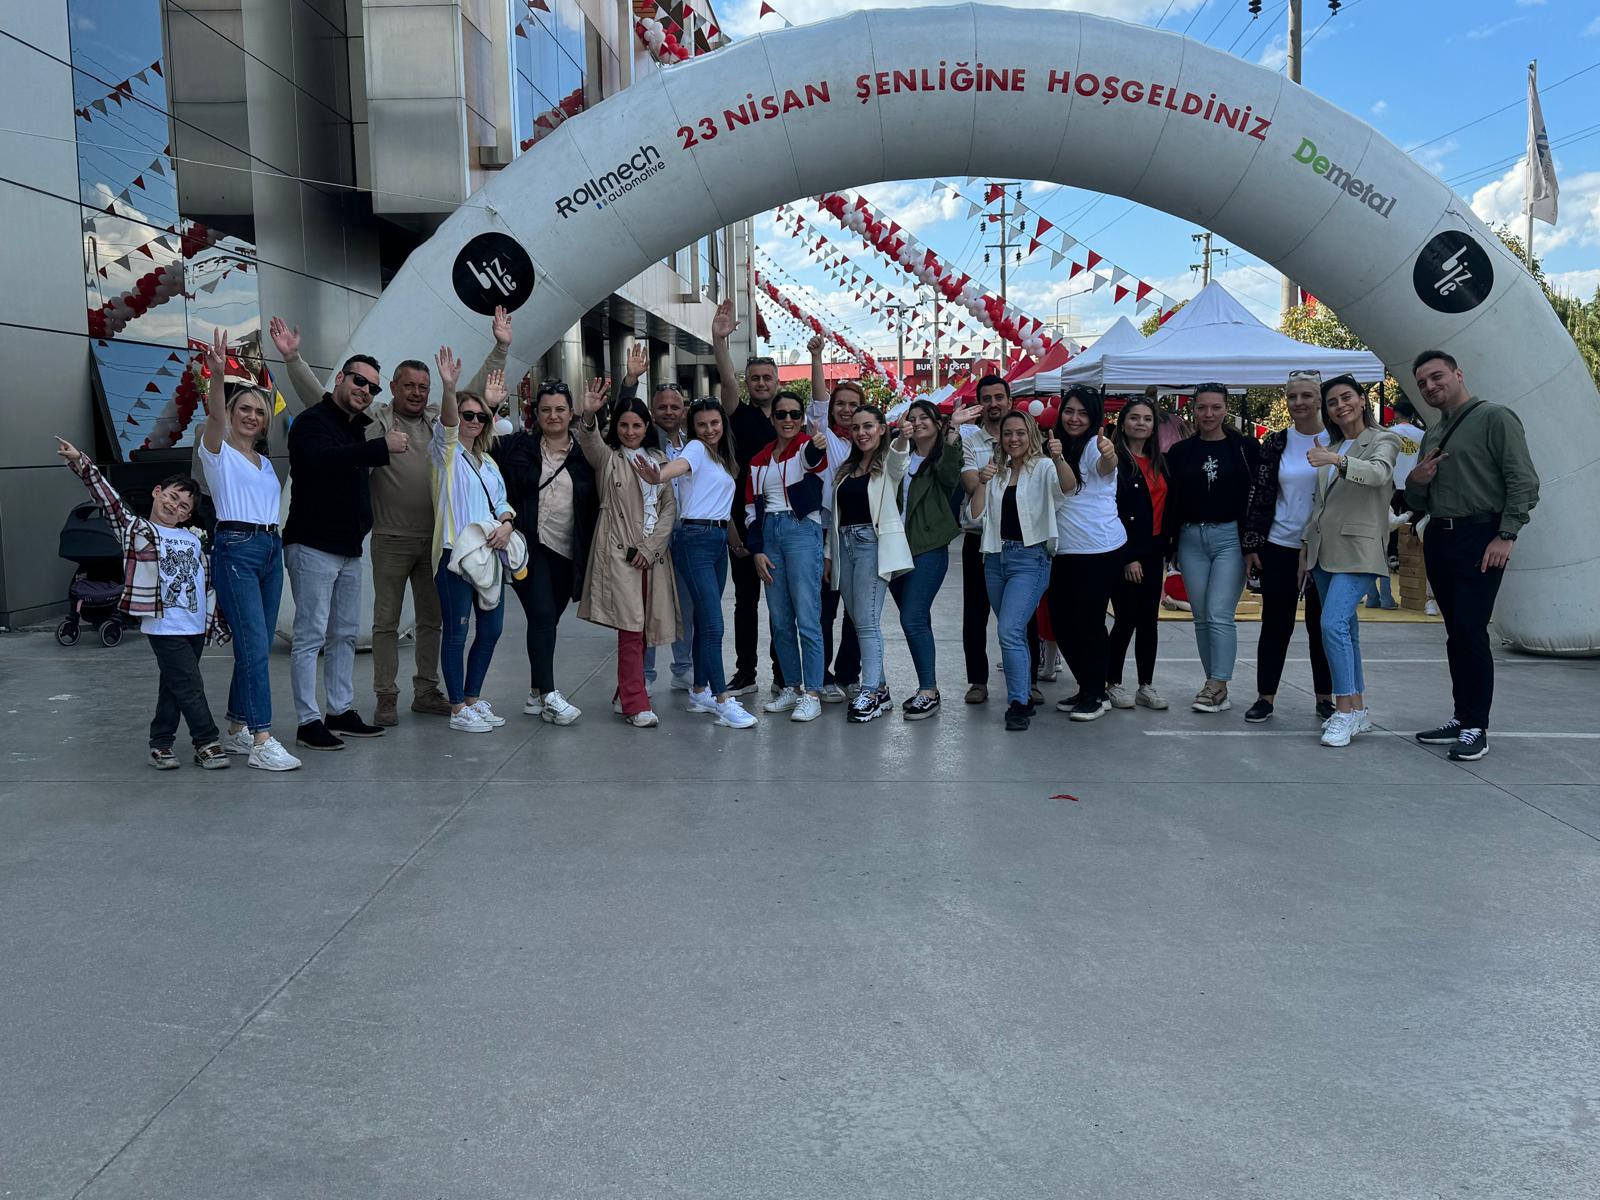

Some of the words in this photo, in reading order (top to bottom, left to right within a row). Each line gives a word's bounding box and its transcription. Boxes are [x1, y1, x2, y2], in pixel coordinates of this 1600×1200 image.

[676, 117, 718, 150] 23
[723, 81, 831, 131] NİSAN
[856, 60, 1026, 105] ŞENLİĞİNE
[1047, 69, 1272, 141] HOŞGELDİNİZ
[555, 145, 661, 219] Rollmech
[608, 161, 666, 202] automotive
[1291, 137, 1398, 219] Demetal
